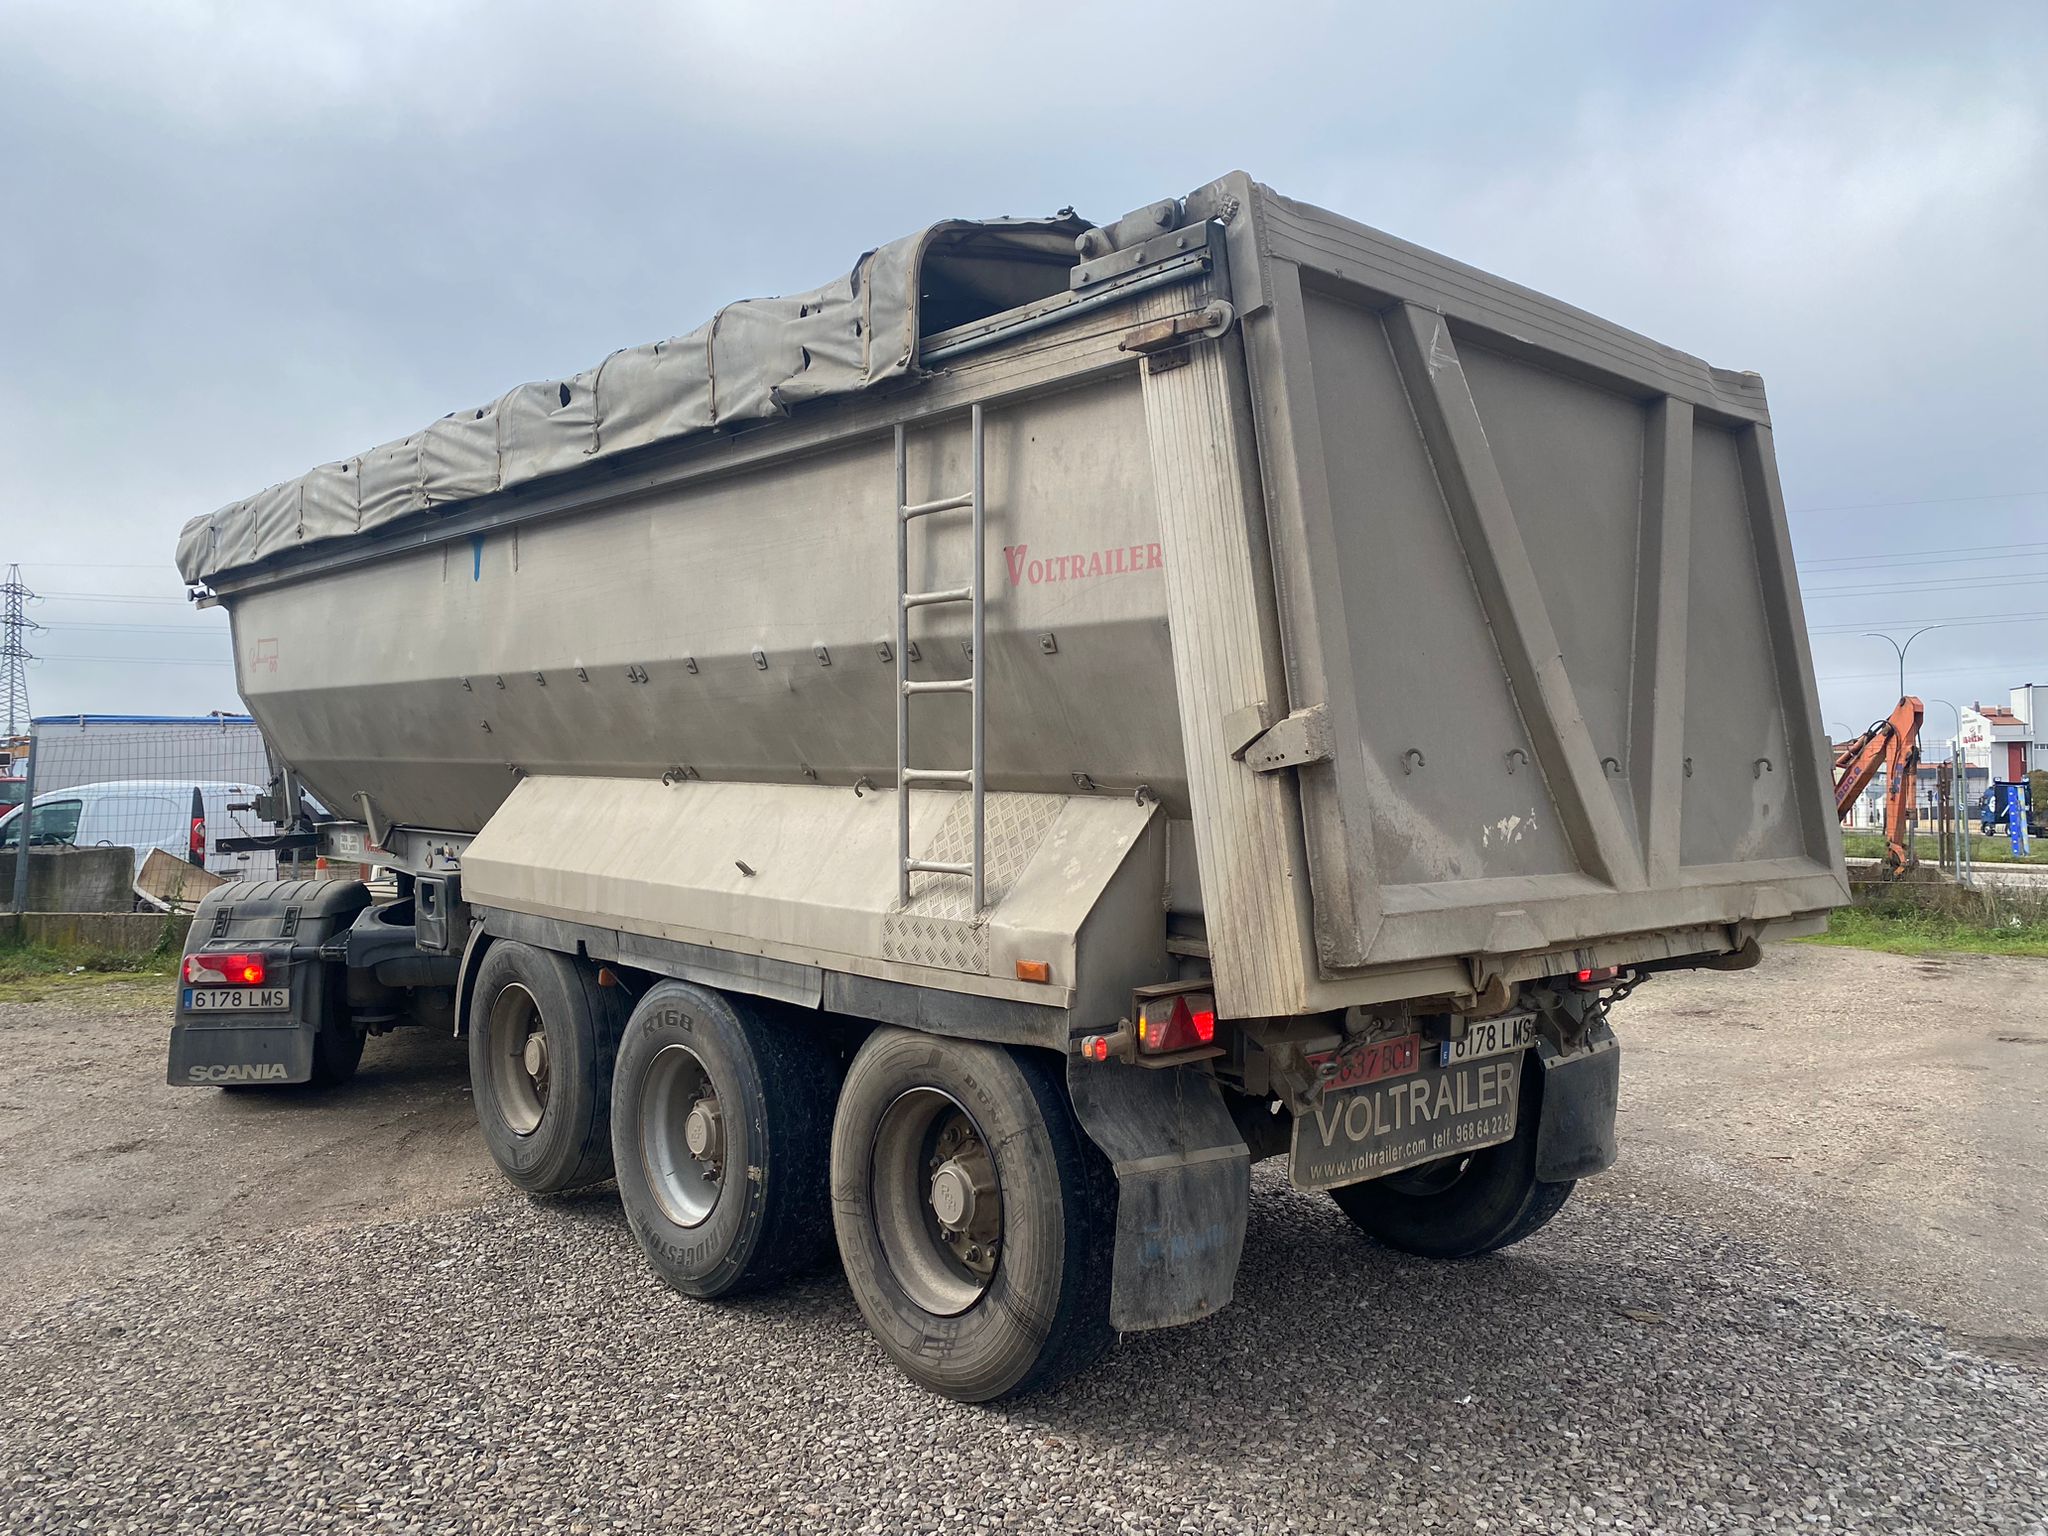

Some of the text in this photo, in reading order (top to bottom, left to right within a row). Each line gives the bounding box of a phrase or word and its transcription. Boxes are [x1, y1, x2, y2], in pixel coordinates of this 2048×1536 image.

[195, 991, 284, 1007] 6178 LMS
[641, 1009, 694, 1039] R168
[1455, 1018, 1532, 1058] 6178 LMS
[188, 1063, 288, 1081] SCANIA
[1314, 1061, 1515, 1147] VOLTRAILER
[1310, 1138, 1427, 1180] www.voltrailer.com
[1432, 1127, 1455, 1150] telf.
[1456, 1121, 1475, 1143] 968
[1476, 1119, 1489, 1138] 64
